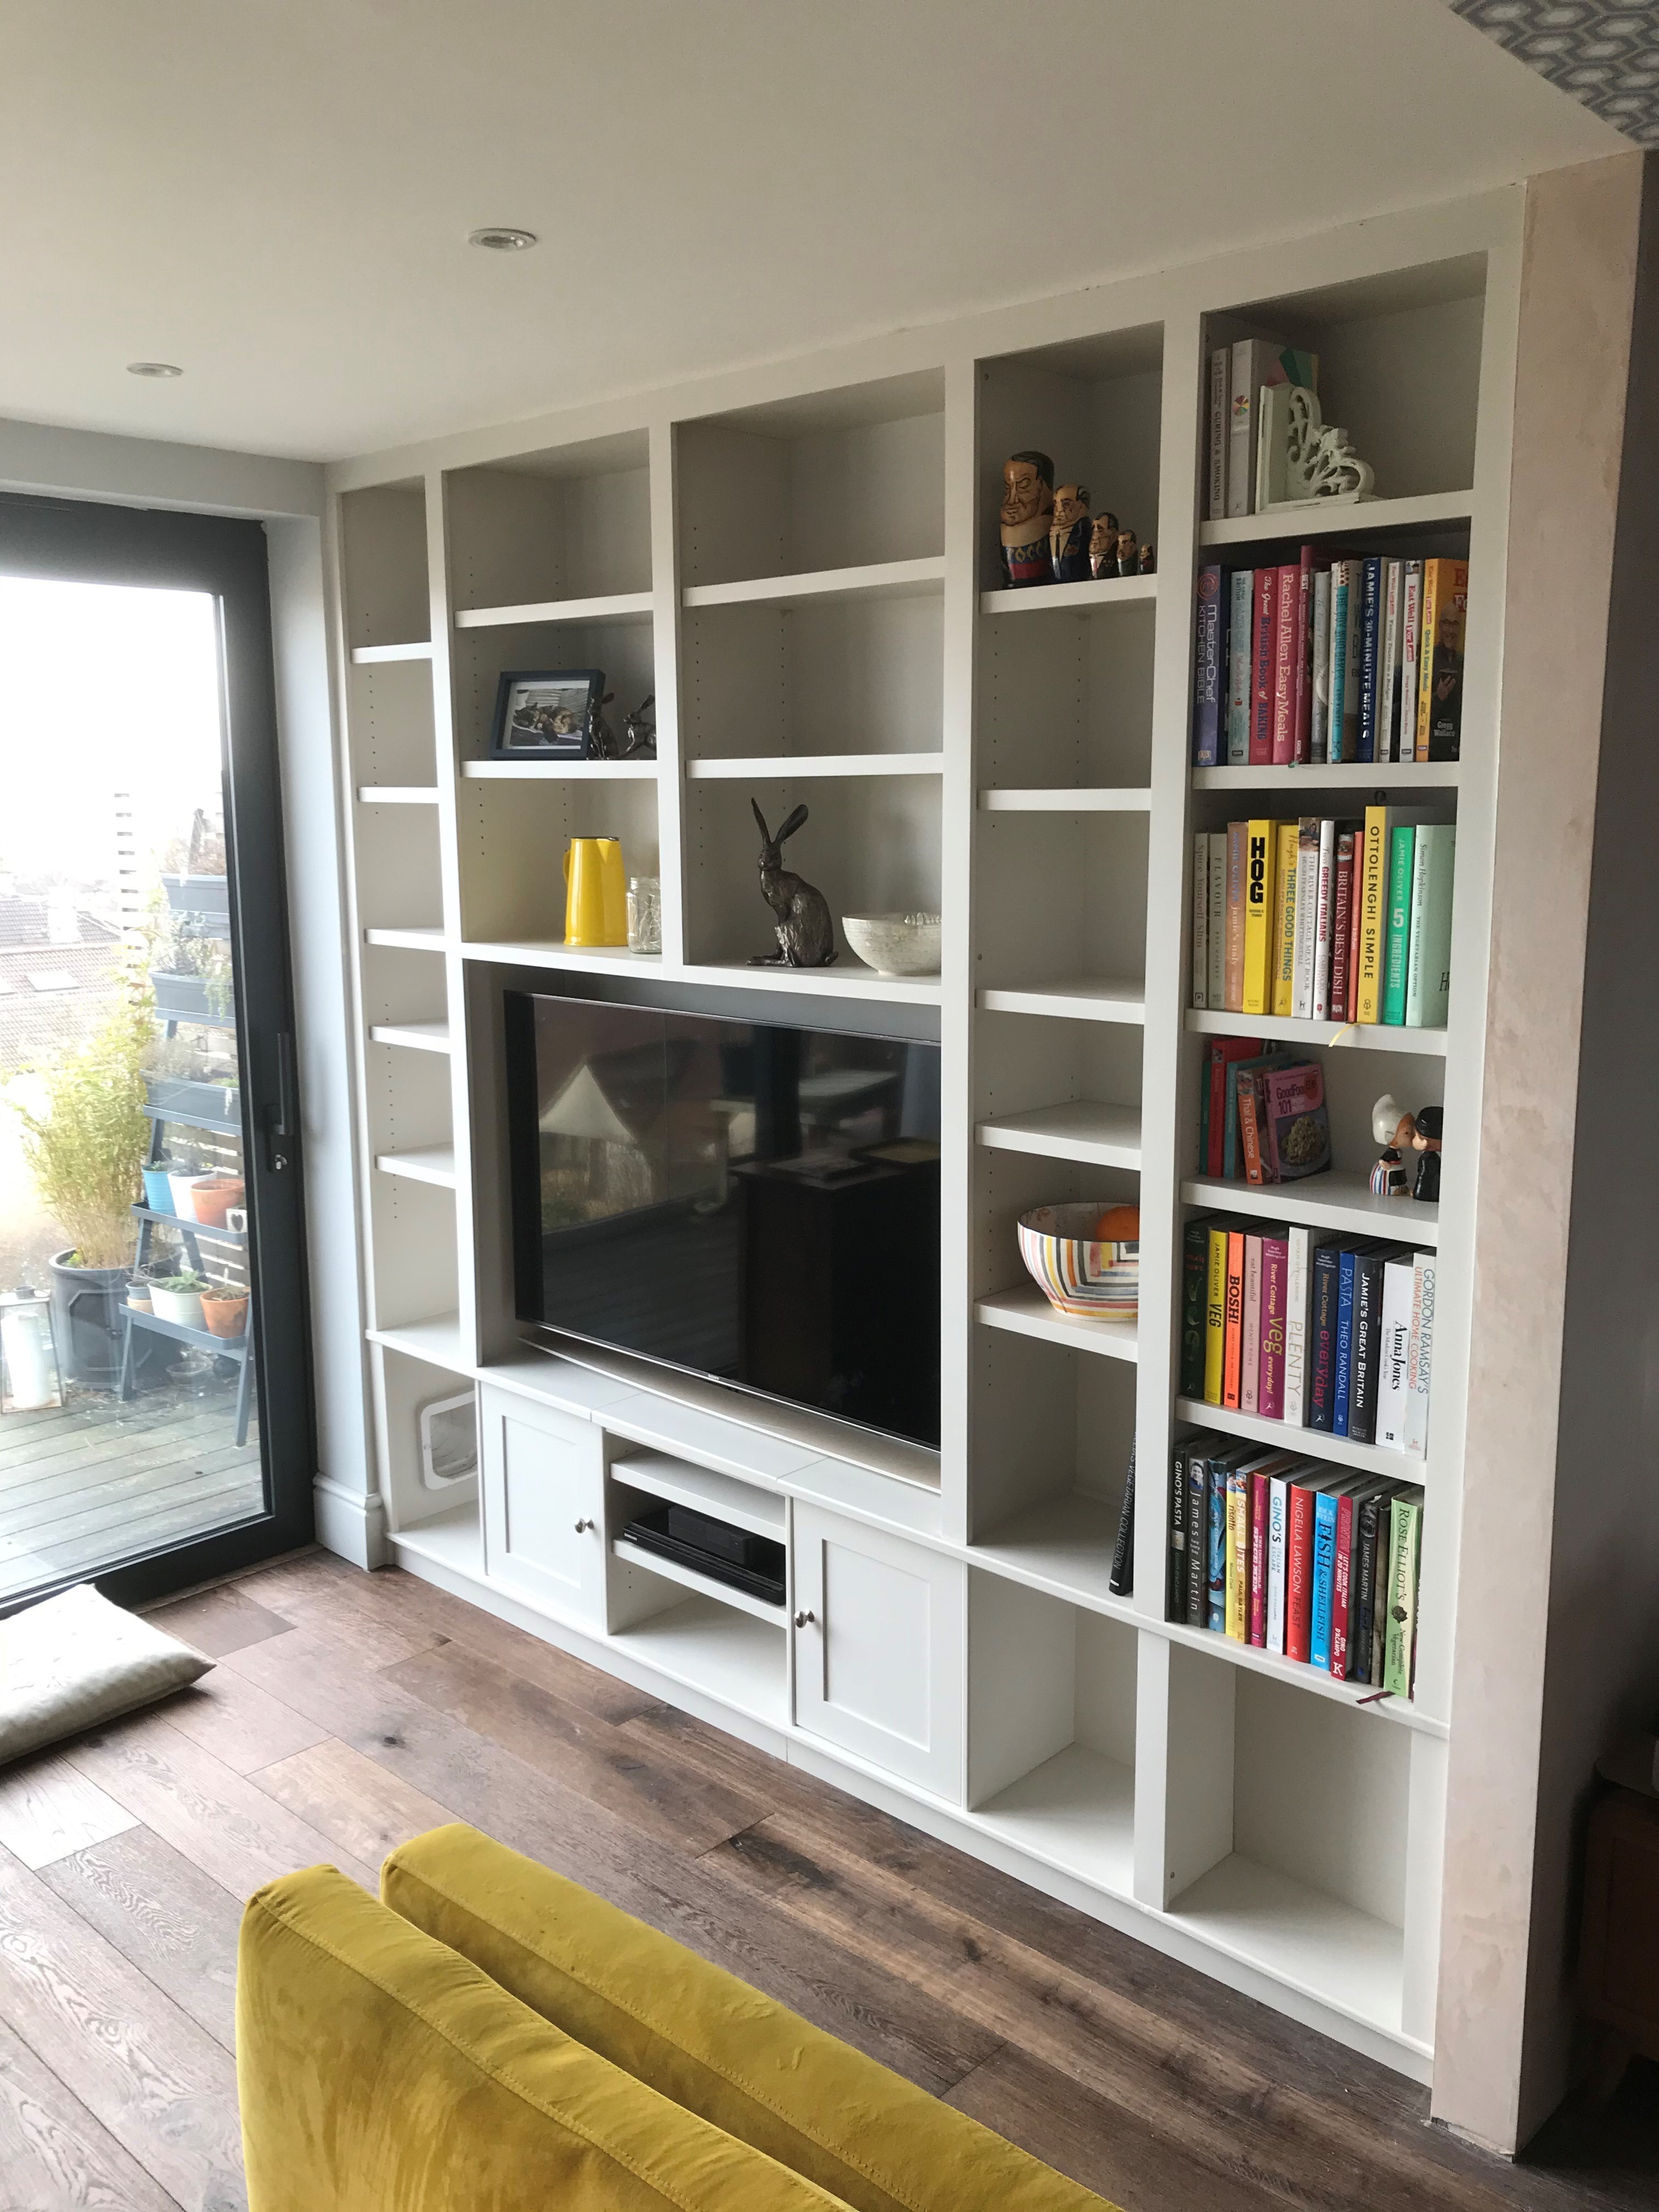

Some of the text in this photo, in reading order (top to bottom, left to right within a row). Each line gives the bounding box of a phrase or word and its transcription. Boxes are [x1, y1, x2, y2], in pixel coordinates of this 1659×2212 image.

[1261, 593, 1270, 615] Great
[1206, 605, 1216, 703] MasterChef
[1260, 617, 1270, 657] British
[1362, 564, 1375, 738] JAMIE'S 30-MINUTE MEALS
[1258, 660, 1268, 689] Book
[1276, 574, 1294, 742] Rachel Allen Easy Meals
[1258, 691, 1267, 700] of
[1257, 702, 1267, 740] BAKING
[1196, 845, 1205, 873] Spice
[1250, 837, 1266, 904] HOG
[1419, 843, 1427, 866] Simon
[1286, 869, 1296, 903] THREE
[1320, 866, 1329, 899] GREEDY
[1416, 869, 1426, 907] Hopkinson
[1364, 826, 1380, 979] OTTOLENGHI SIMPLE
[1393, 908, 1404, 927] 5
[1285, 906, 1294, 938] GOOD
[1319, 903, 1328, 942] ITALIANS
[1333, 870, 1347, 995] BRITAIN'S BEST DISH
[1283, 941, 1293, 981] THINGS
[1390, 934, 1403, 988] INGREDIENTS
[1242, 1098, 1252, 1115] Thai
[1278, 1100, 1292, 1115] 101
[1245, 1126, 1255, 1159] Chinese
[1228, 1275, 1240, 1324] BOSH!
[1249, 1270, 1257, 1302] beautiful
[1208, 1304, 1222, 1327] VEG
[1320, 1295, 1329, 1326] Cottage
[1409, 1267, 1422, 1389] ULTIMATE HOME COOKING
[1263, 1318, 1284, 1356] veg
[1337, 1268, 1353, 1400] PASTA THEO RANDALL
[1356, 1273, 1370, 1408] JAMIE'S GREAT BRITAIN
[1417, 1269, 1435, 1394] GORDON RAMSAY'S
[1287, 1321, 1303, 1396] PLENTY
[1312, 1330, 1330, 1408] everyday
[1391, 1321, 1408, 1391] Anna Jones
[1174, 1461, 1183, 1495] GINO'S
[1113, 1464, 1136, 1570] VEGETARIAN COLLECTION
[1174, 1497, 1182, 1526] PASTA
[1190, 1490, 1201, 1535] James
[1237, 1500, 1245, 1538] SMALL
[1272, 1496, 1282, 1543] GINO'S
[1236, 1541, 1245, 1573] BITES
[1292, 1497, 1304, 1628] NIGELLA LAWSON FEAST
[1337, 1560, 1343, 1568] 20
[1396, 1508, 1409, 1601] ROSE ELLIOT'S
[1190, 1558, 1200, 1610] Martin
[1317, 1522, 1332, 1641] FISH & SHELLFISH
[1360, 1569, 1369, 1600] MARTIN
[1391, 1632, 1399, 1665] Vegetarian
[1397, 1645, 1405, 1675] Complete
